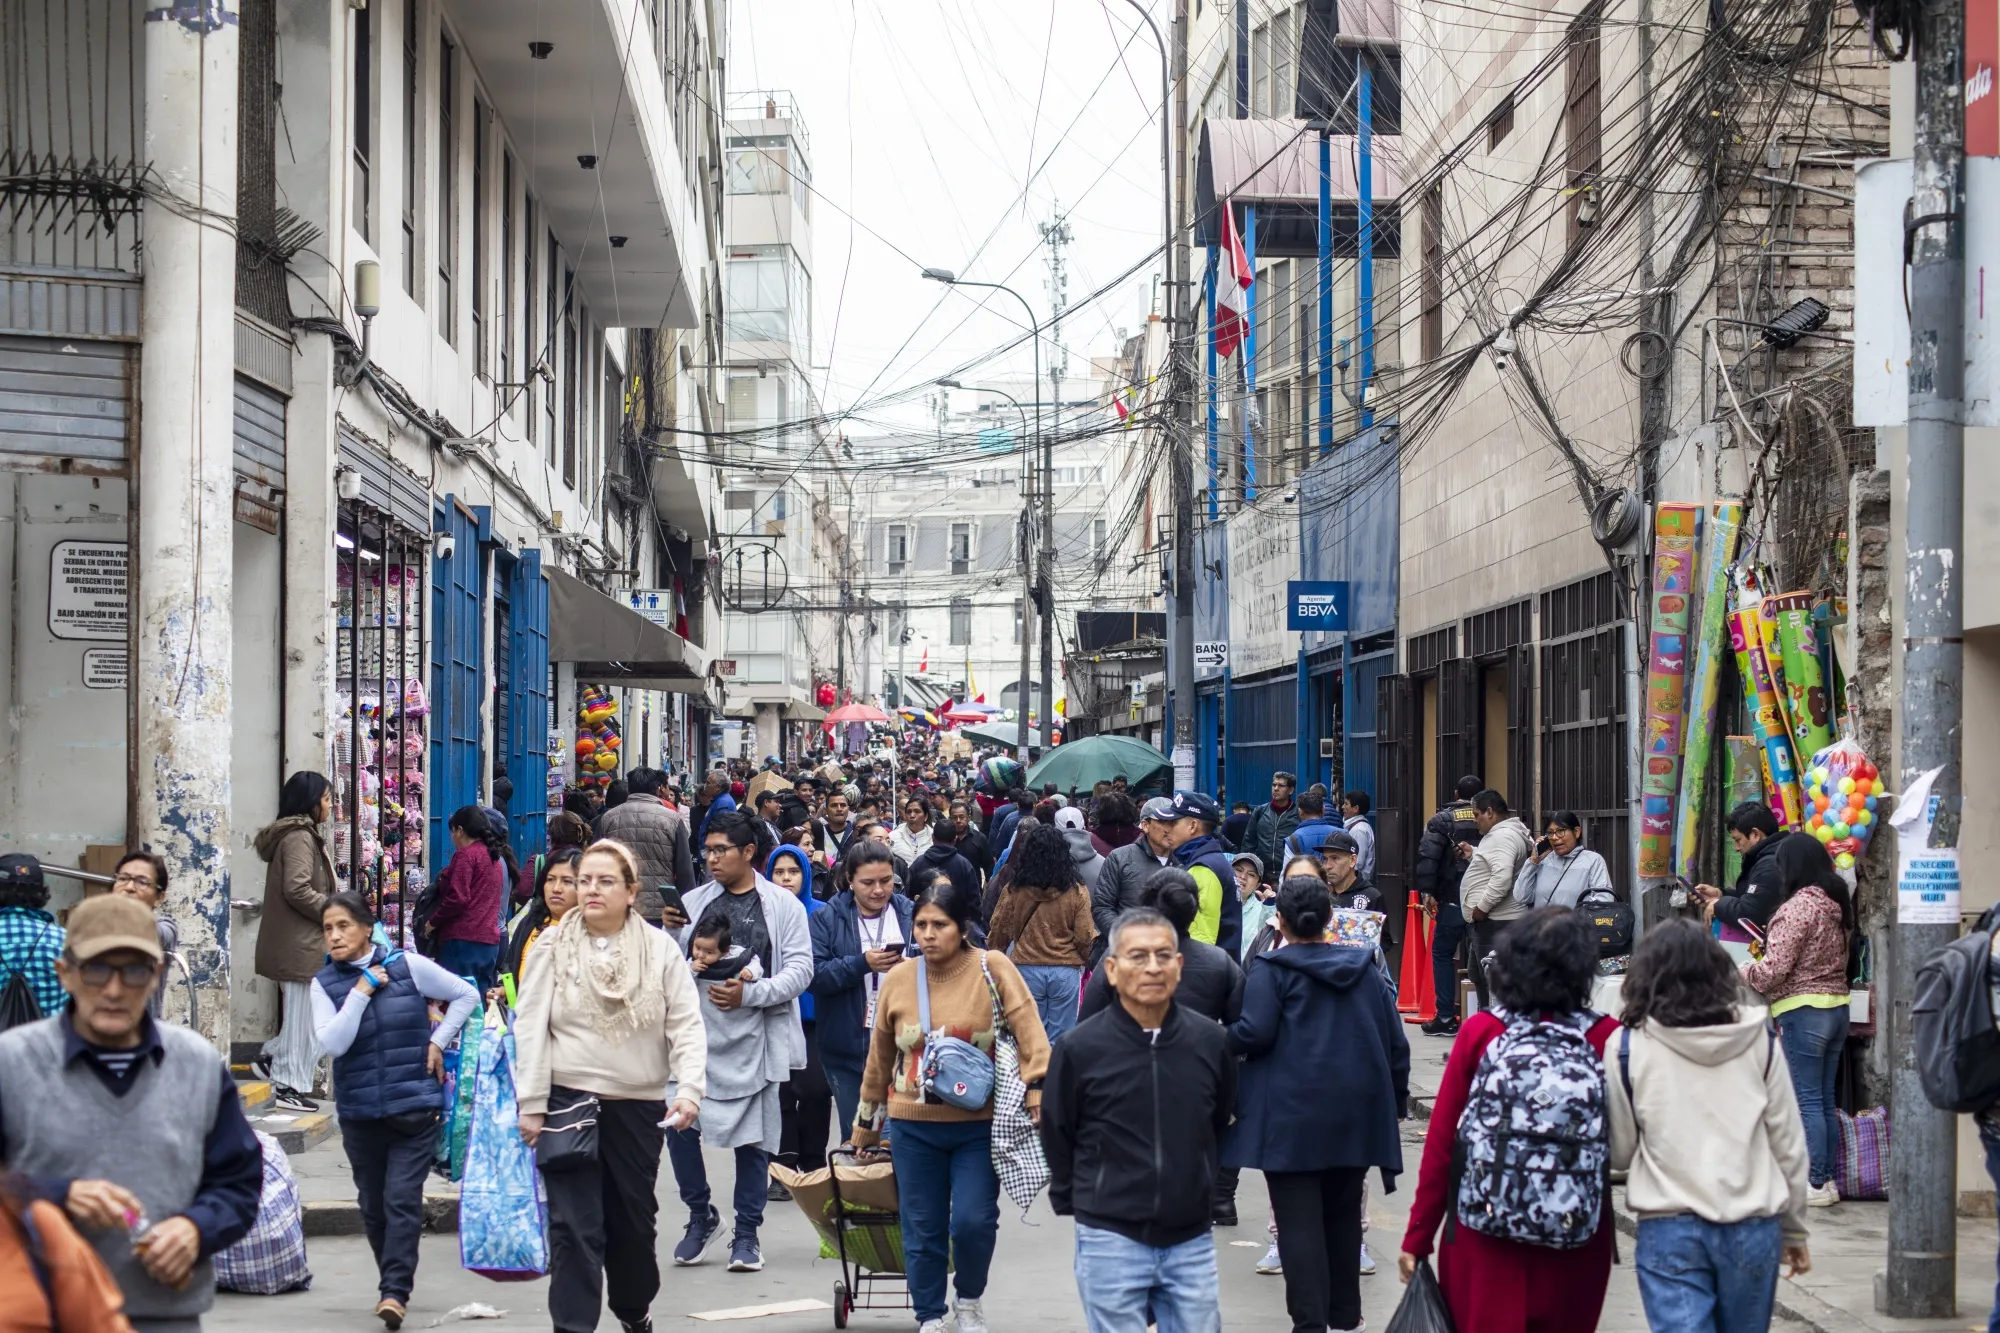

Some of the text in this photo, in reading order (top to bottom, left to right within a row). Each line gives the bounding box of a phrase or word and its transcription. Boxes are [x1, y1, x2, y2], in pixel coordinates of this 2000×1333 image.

[78, 549, 114, 557] ENCUENTRA
[63, 558, 86, 566] SEXUAL
[88, 558, 95, 566] EN
[96, 559, 121, 567] CONTRA
[71, 568, 101, 576] ESPECIAL,
[65, 576, 125, 586] ADOLESCENTES QUE
[79, 586, 112, 594] TRANSITEN
[57, 609, 75, 617] BAJO
[76, 608, 106, 618] SANCIÓN
[107, 611, 116, 619] DE
[1298, 604, 1338, 616] BBVA
[1196, 642, 1226, 653] BAÑO
[1910, 860, 1918, 869] SE
[1905, 871, 1942, 880] PERSONAL
[1920, 893, 1945, 902] MUJER
